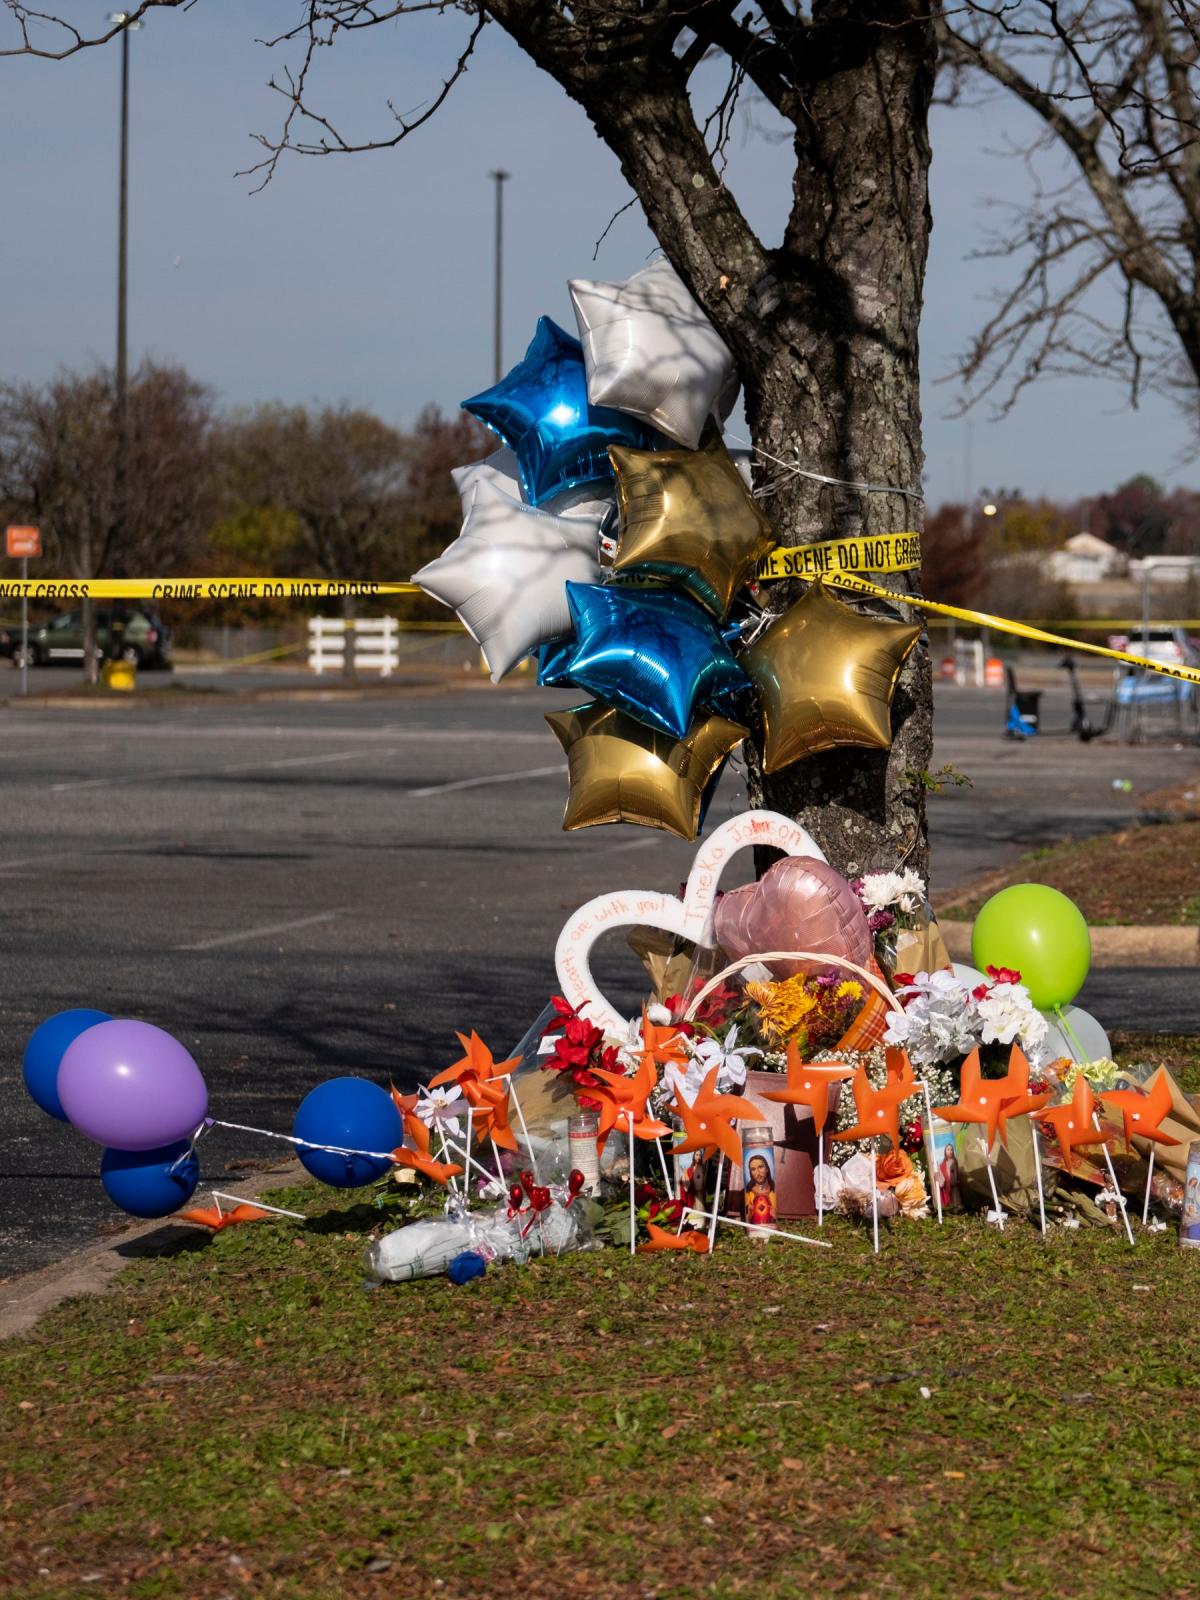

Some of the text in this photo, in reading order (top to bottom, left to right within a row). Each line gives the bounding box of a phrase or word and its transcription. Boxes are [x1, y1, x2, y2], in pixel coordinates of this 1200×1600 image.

[784, 547, 834, 575] SCENE
[838, 543, 859, 569] DO
[864, 541, 891, 568] NOT
[0, 584, 89, 599] NOT CROSS
[152, 584, 202, 600] CRIME
[208, 583, 257, 600] SCENE
